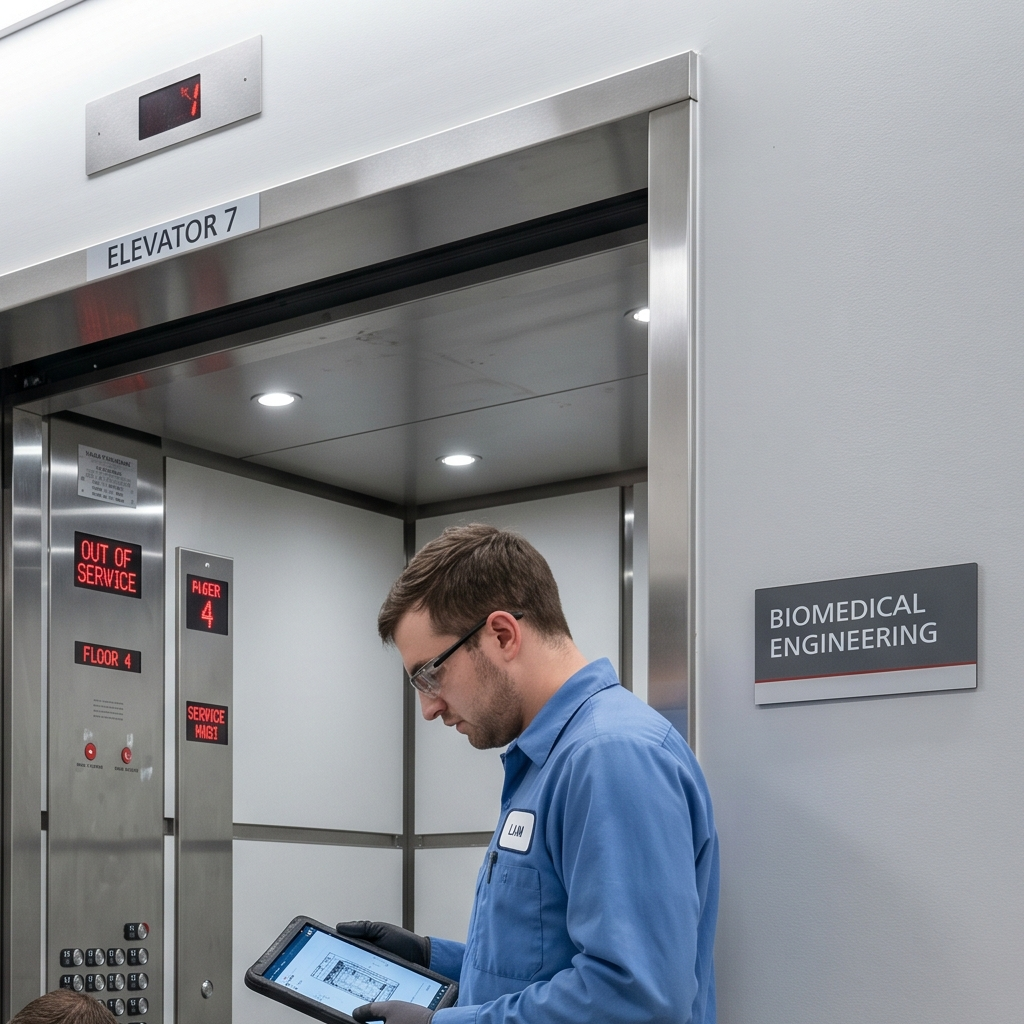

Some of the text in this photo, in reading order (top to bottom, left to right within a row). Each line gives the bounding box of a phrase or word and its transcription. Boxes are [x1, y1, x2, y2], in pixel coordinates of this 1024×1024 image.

[108, 206, 238, 270] ELEVATOR 7
[81, 539, 133, 569] OUT OF
[77, 562, 137, 593] SERVICE
[201, 600, 214, 629] 4
[770, 593, 926, 629] BIOMEDICAL
[770, 621, 938, 659] ENGINEERING
[83, 645, 132, 669] FLOOR 4
[187, 705, 226, 725] SERVICE
